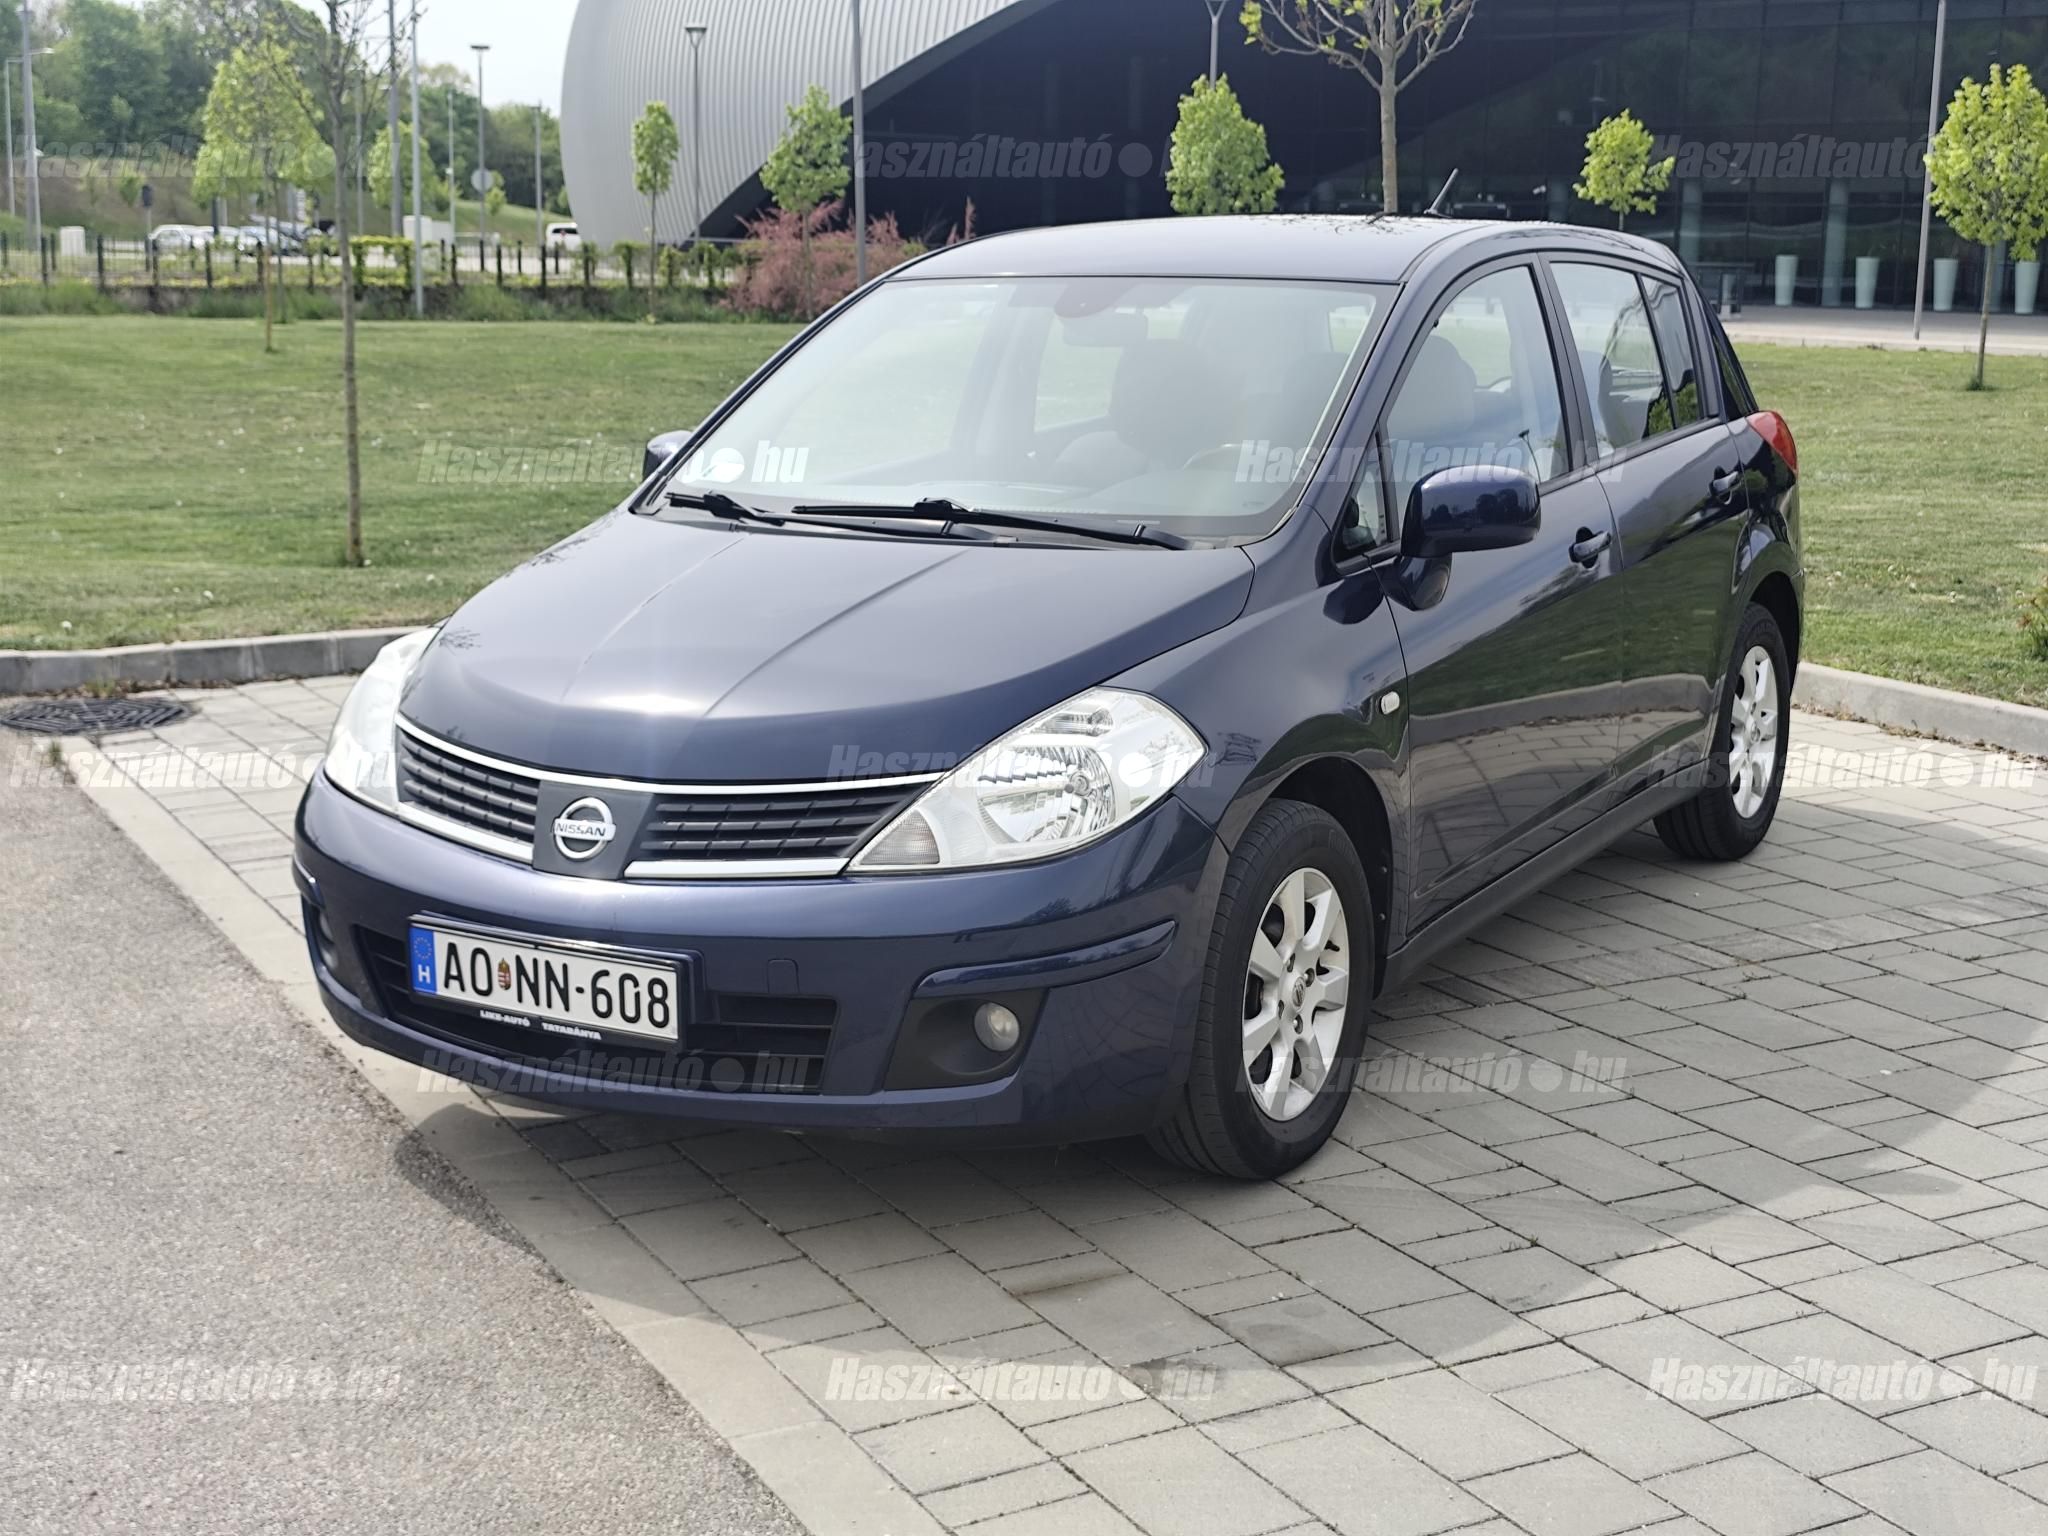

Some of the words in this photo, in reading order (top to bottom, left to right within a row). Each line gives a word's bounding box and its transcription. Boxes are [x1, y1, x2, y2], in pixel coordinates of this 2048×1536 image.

[555, 822, 606, 837] NISSAN
[417, 965, 431, 985] H
[515, 954, 670, 1029] NN-608
[541, 1022, 602, 1041] TATABÁNYA
